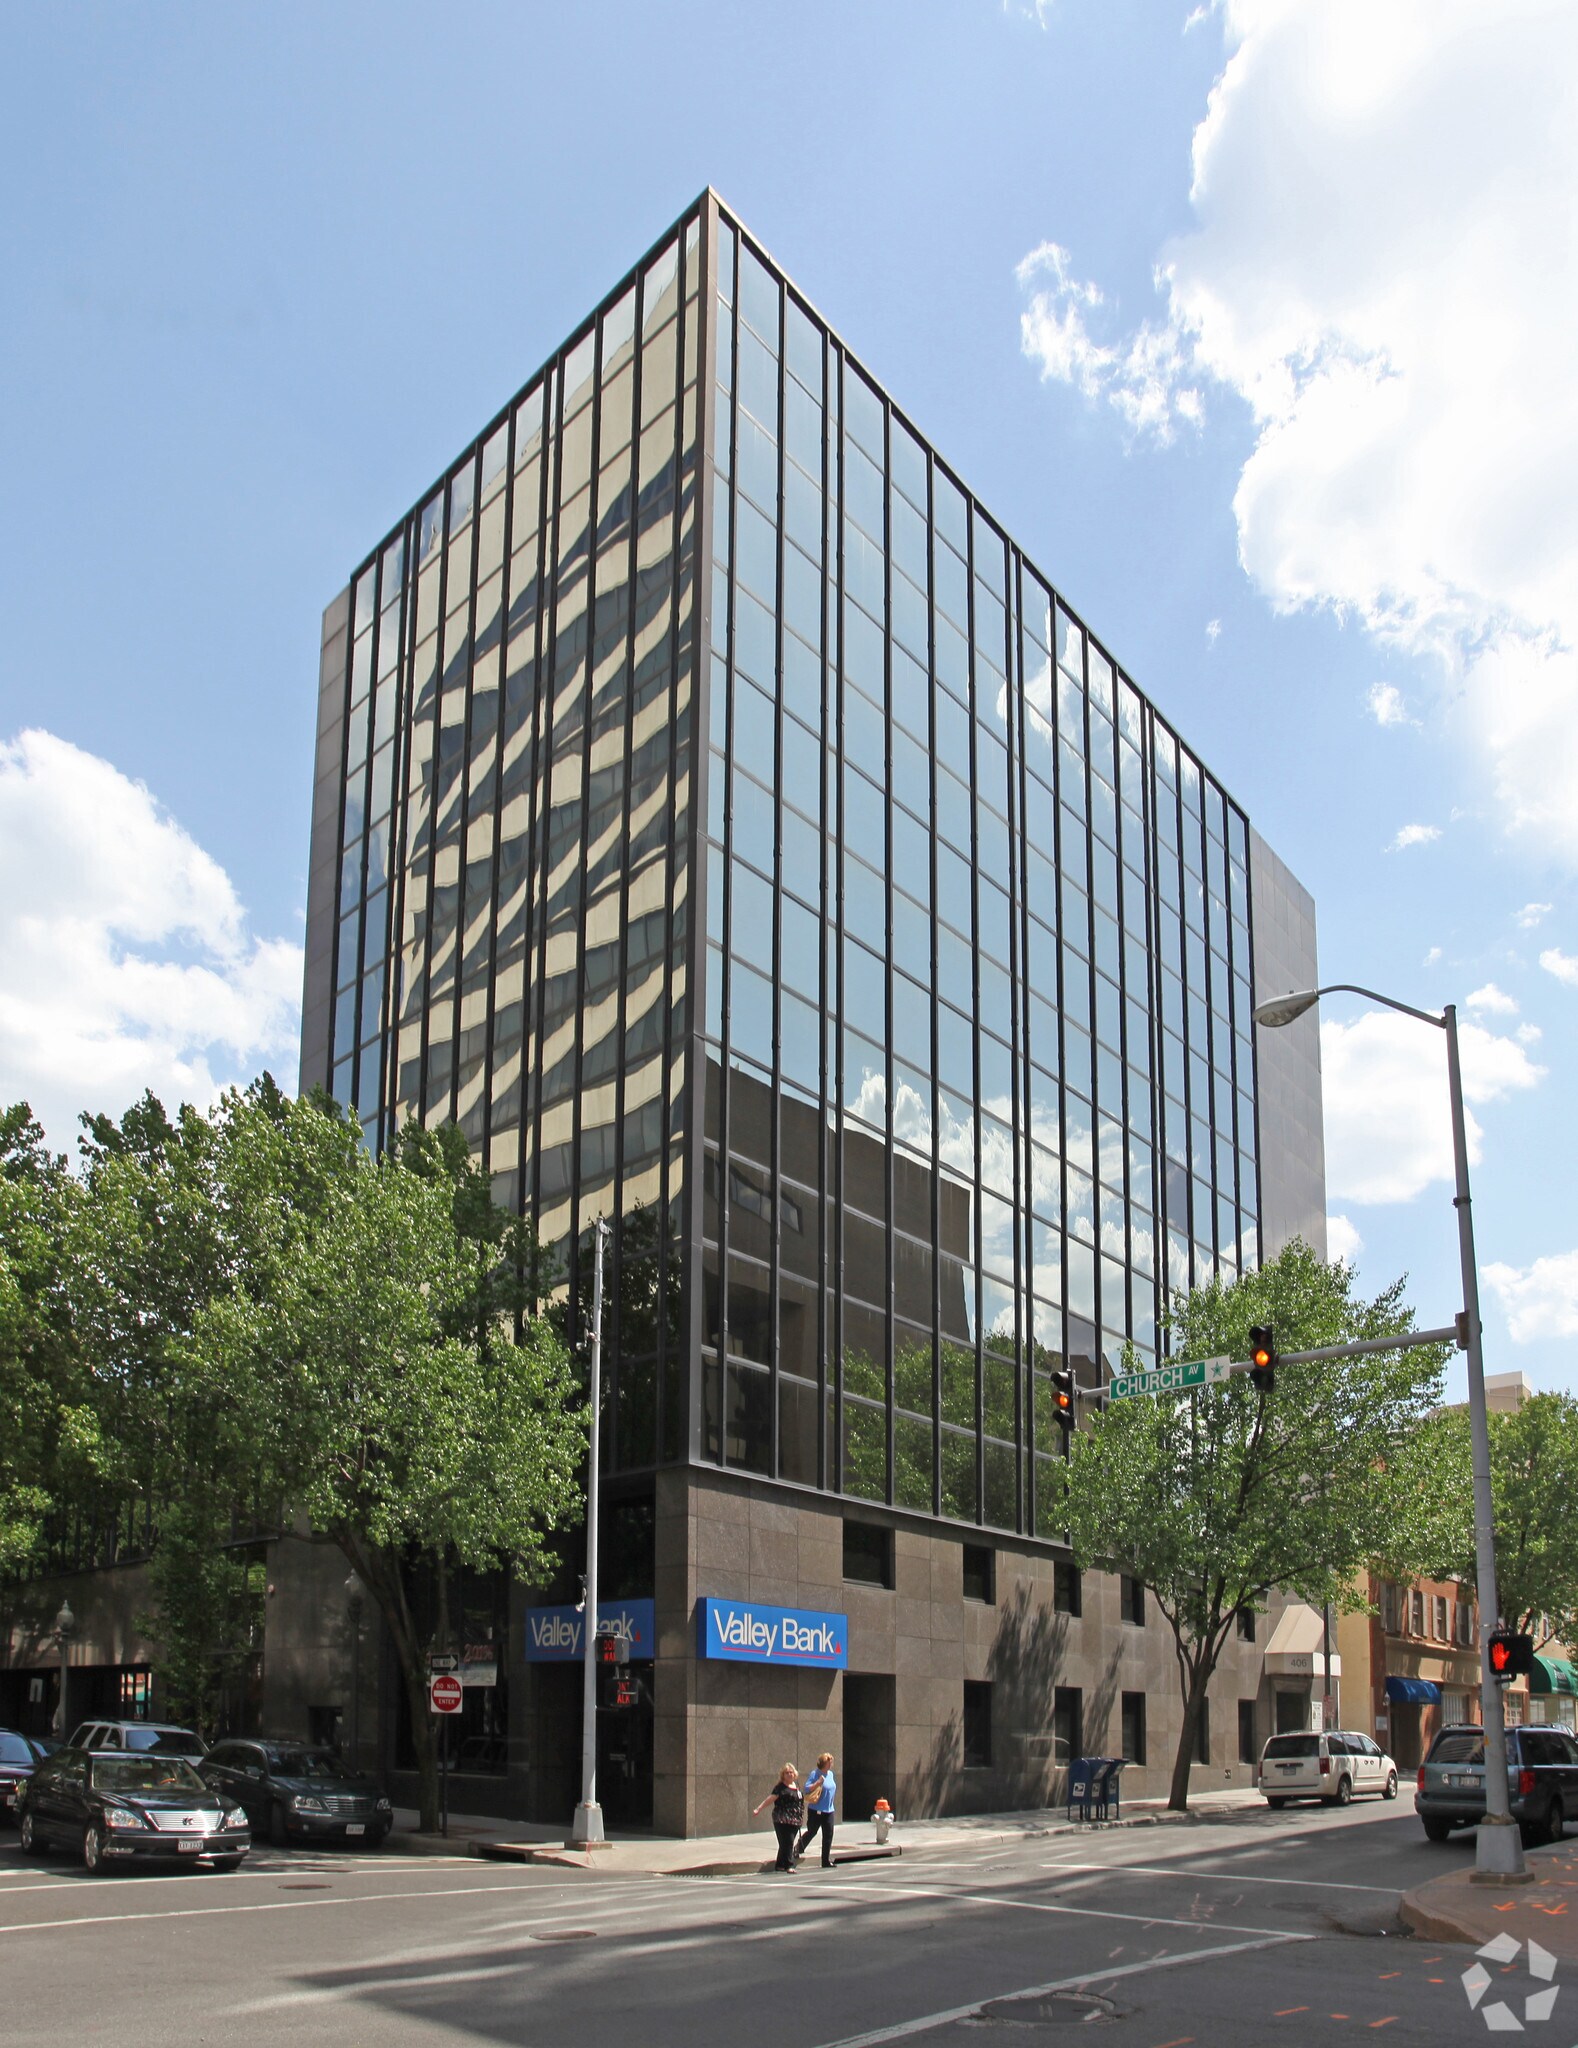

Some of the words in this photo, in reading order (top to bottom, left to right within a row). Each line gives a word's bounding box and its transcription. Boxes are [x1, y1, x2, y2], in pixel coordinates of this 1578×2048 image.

[1116, 1367, 1183, 1396] CHURCH
[1188, 1365, 1199, 1376] AV
[531, 1616, 581, 1655] Valley
[597, 1611, 634, 1643] ank
[713, 1608, 778, 1657] Valley
[782, 1617, 834, 1653] Bank
[1291, 1658, 1307, 1668] 406
[617, 1694, 631, 1704] ALK
